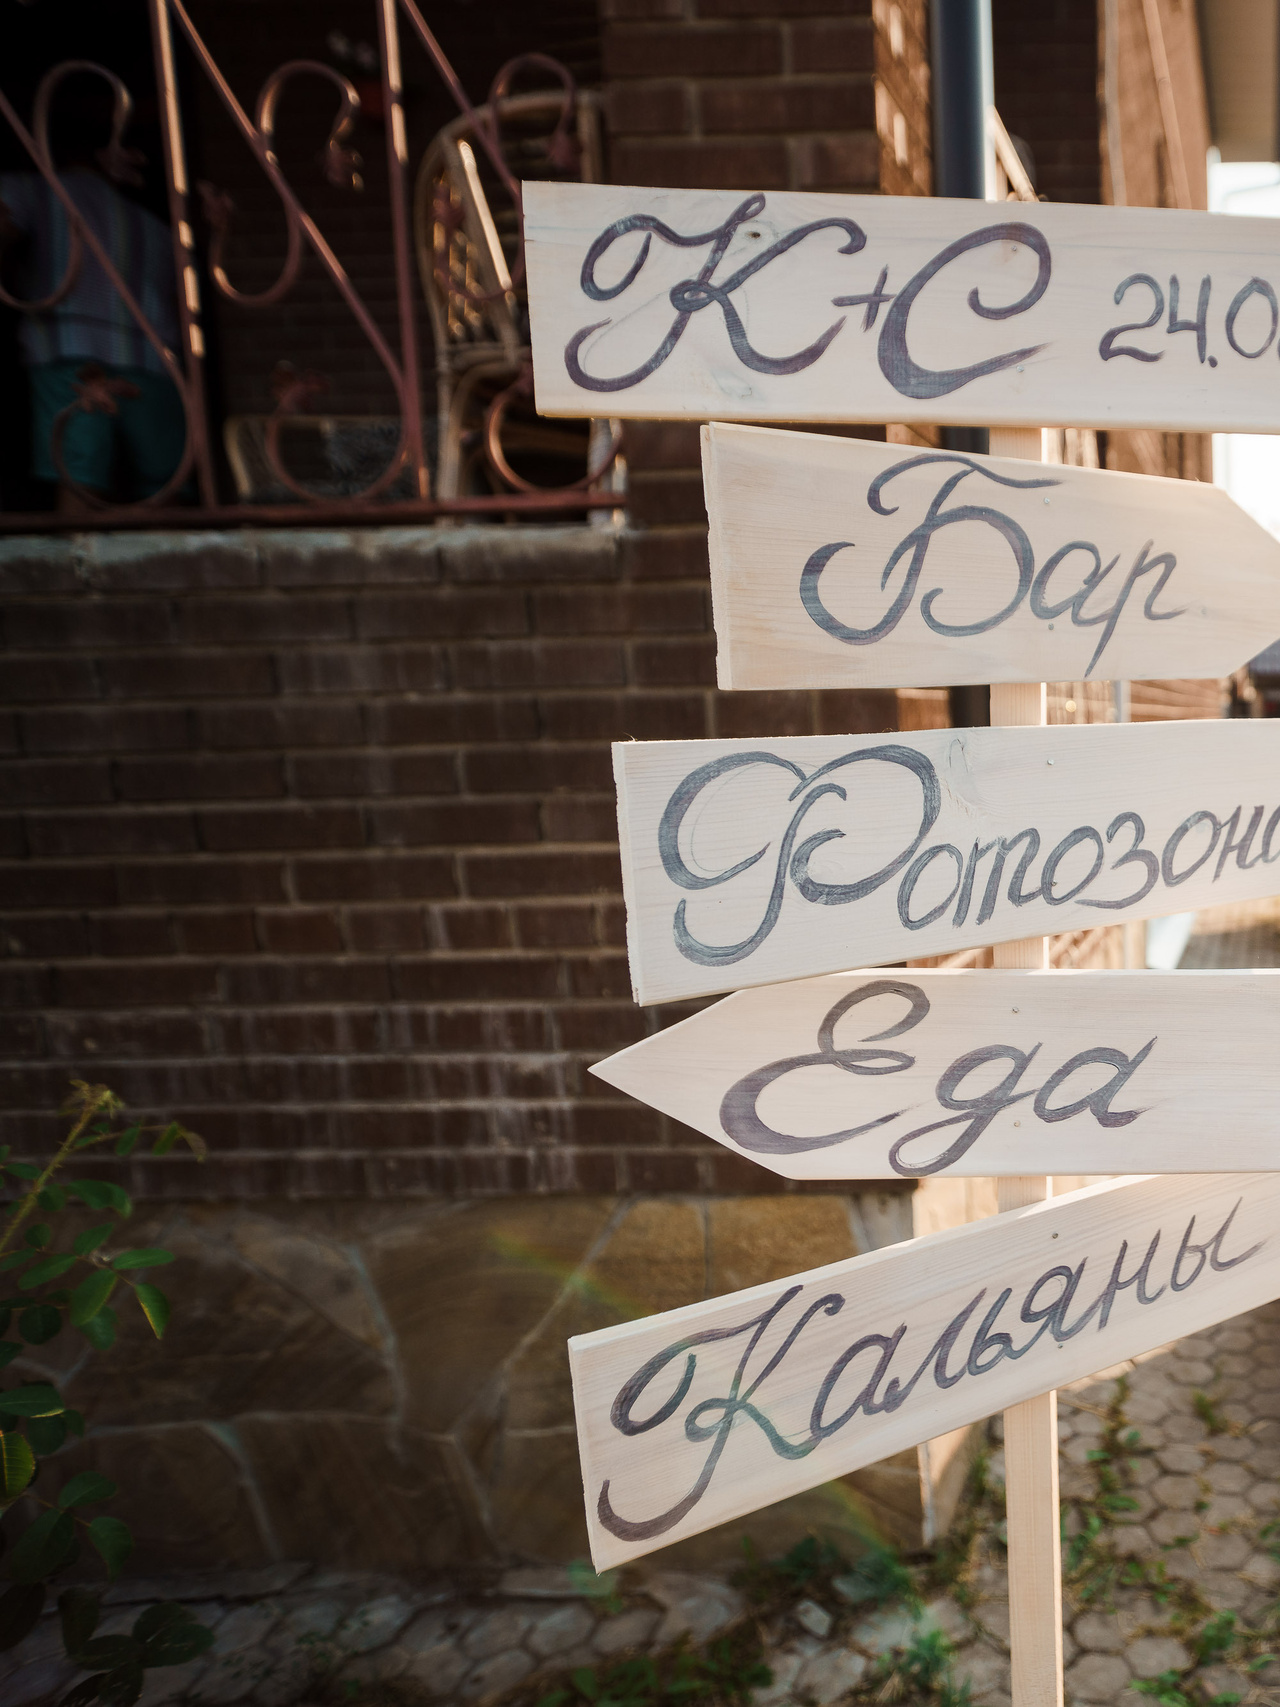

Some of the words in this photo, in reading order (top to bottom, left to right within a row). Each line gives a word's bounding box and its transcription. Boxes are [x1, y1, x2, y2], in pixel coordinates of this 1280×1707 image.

[799, 453, 1191, 679] Бар
[719, 979, 1158, 1176] Еда
[597, 1196, 1268, 1542] Кальяны
